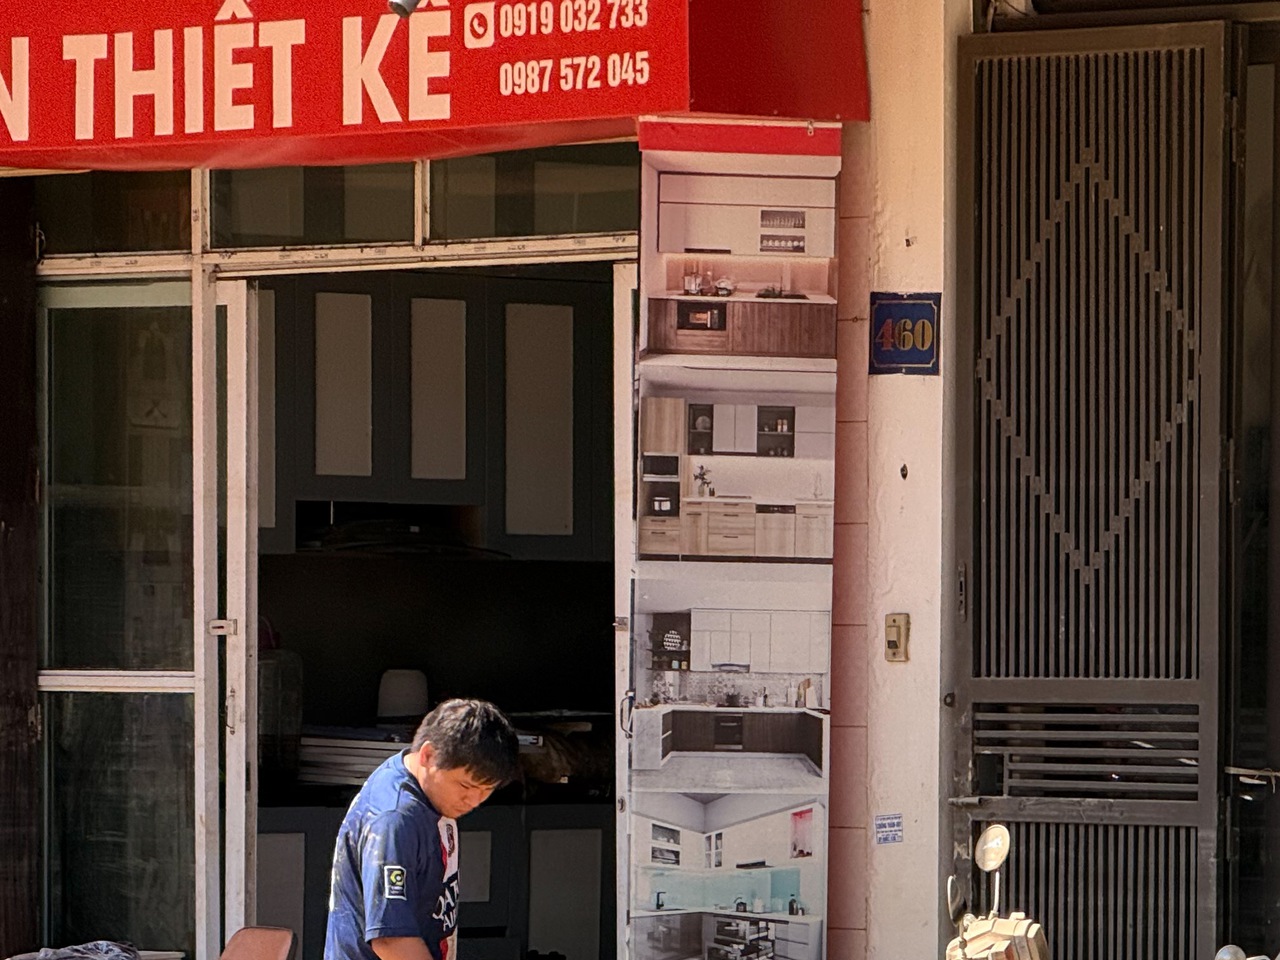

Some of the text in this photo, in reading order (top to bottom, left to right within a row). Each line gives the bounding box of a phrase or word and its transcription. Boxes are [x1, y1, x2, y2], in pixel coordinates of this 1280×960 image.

[500, 0, 648, 38] 0919 032 733
[500, 51, 650, 96] 0987 572 045
[875, 318, 934, 352] 460
